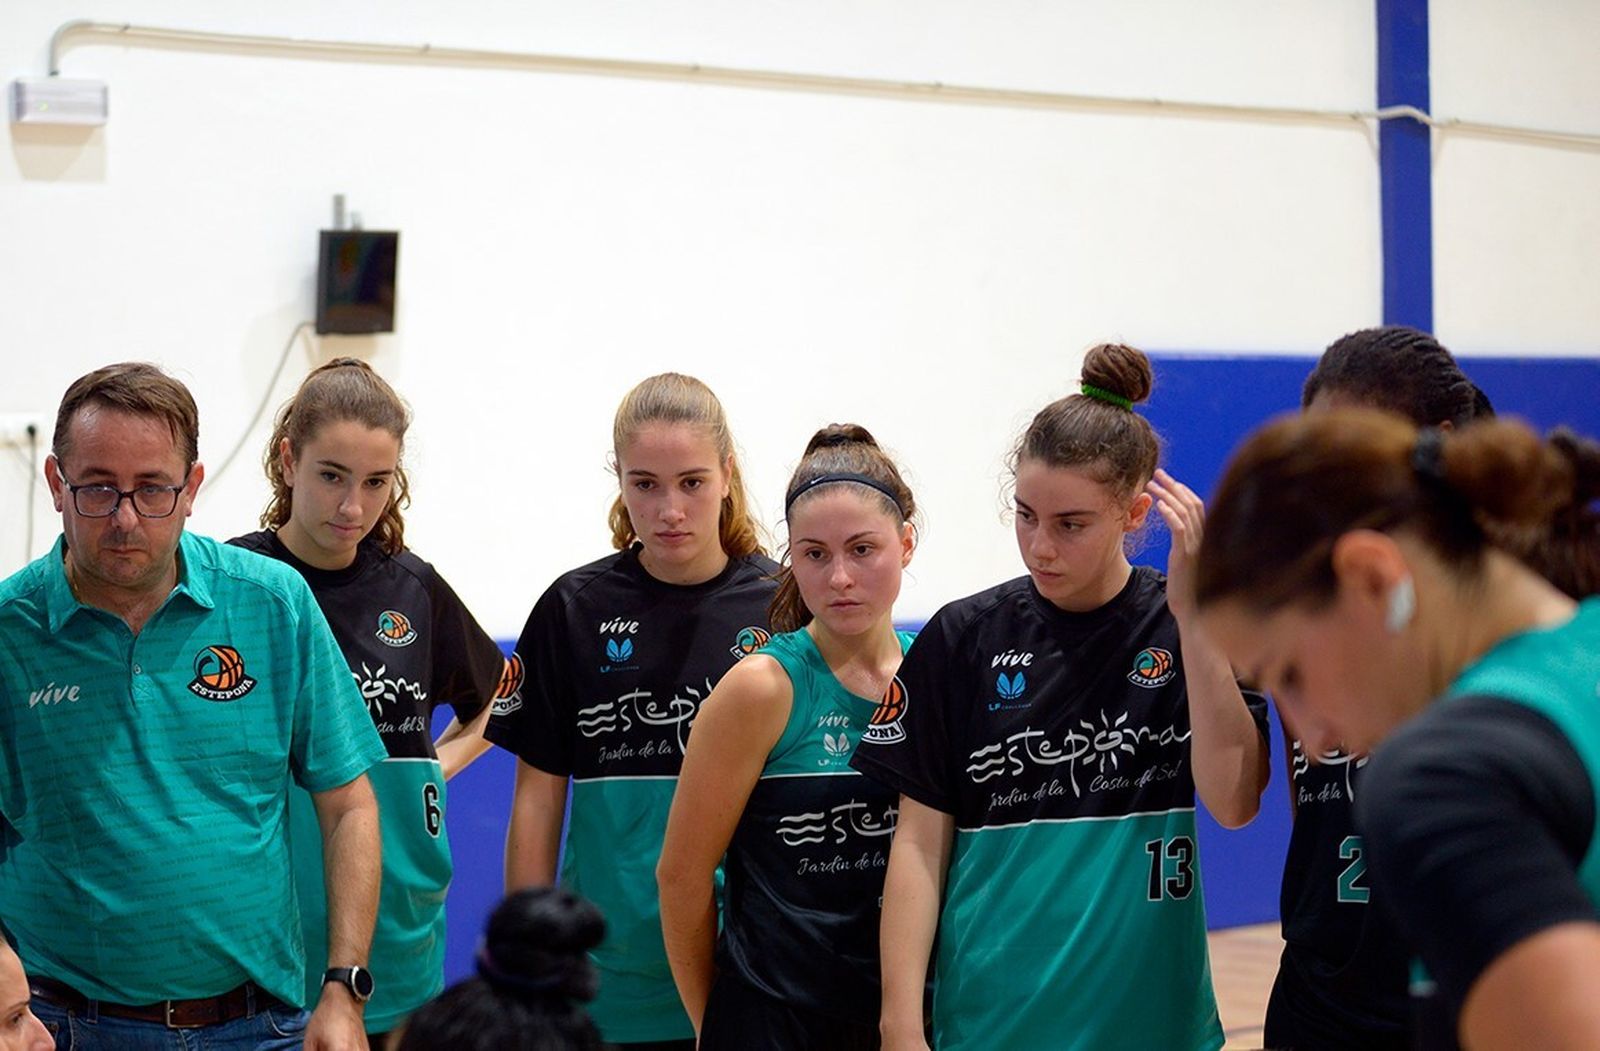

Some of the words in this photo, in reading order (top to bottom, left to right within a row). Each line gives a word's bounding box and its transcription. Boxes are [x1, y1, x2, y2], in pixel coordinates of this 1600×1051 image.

[191, 679, 254, 700] ESTEPONA
[577, 682, 708, 757] Estep
[657, 739, 674, 755] la
[1088, 774, 1131, 793] Costa
[422, 782, 442, 838] 6
[854, 852, 870, 871] de
[871, 850, 887, 868] la
[1145, 836, 1195, 902] 13
